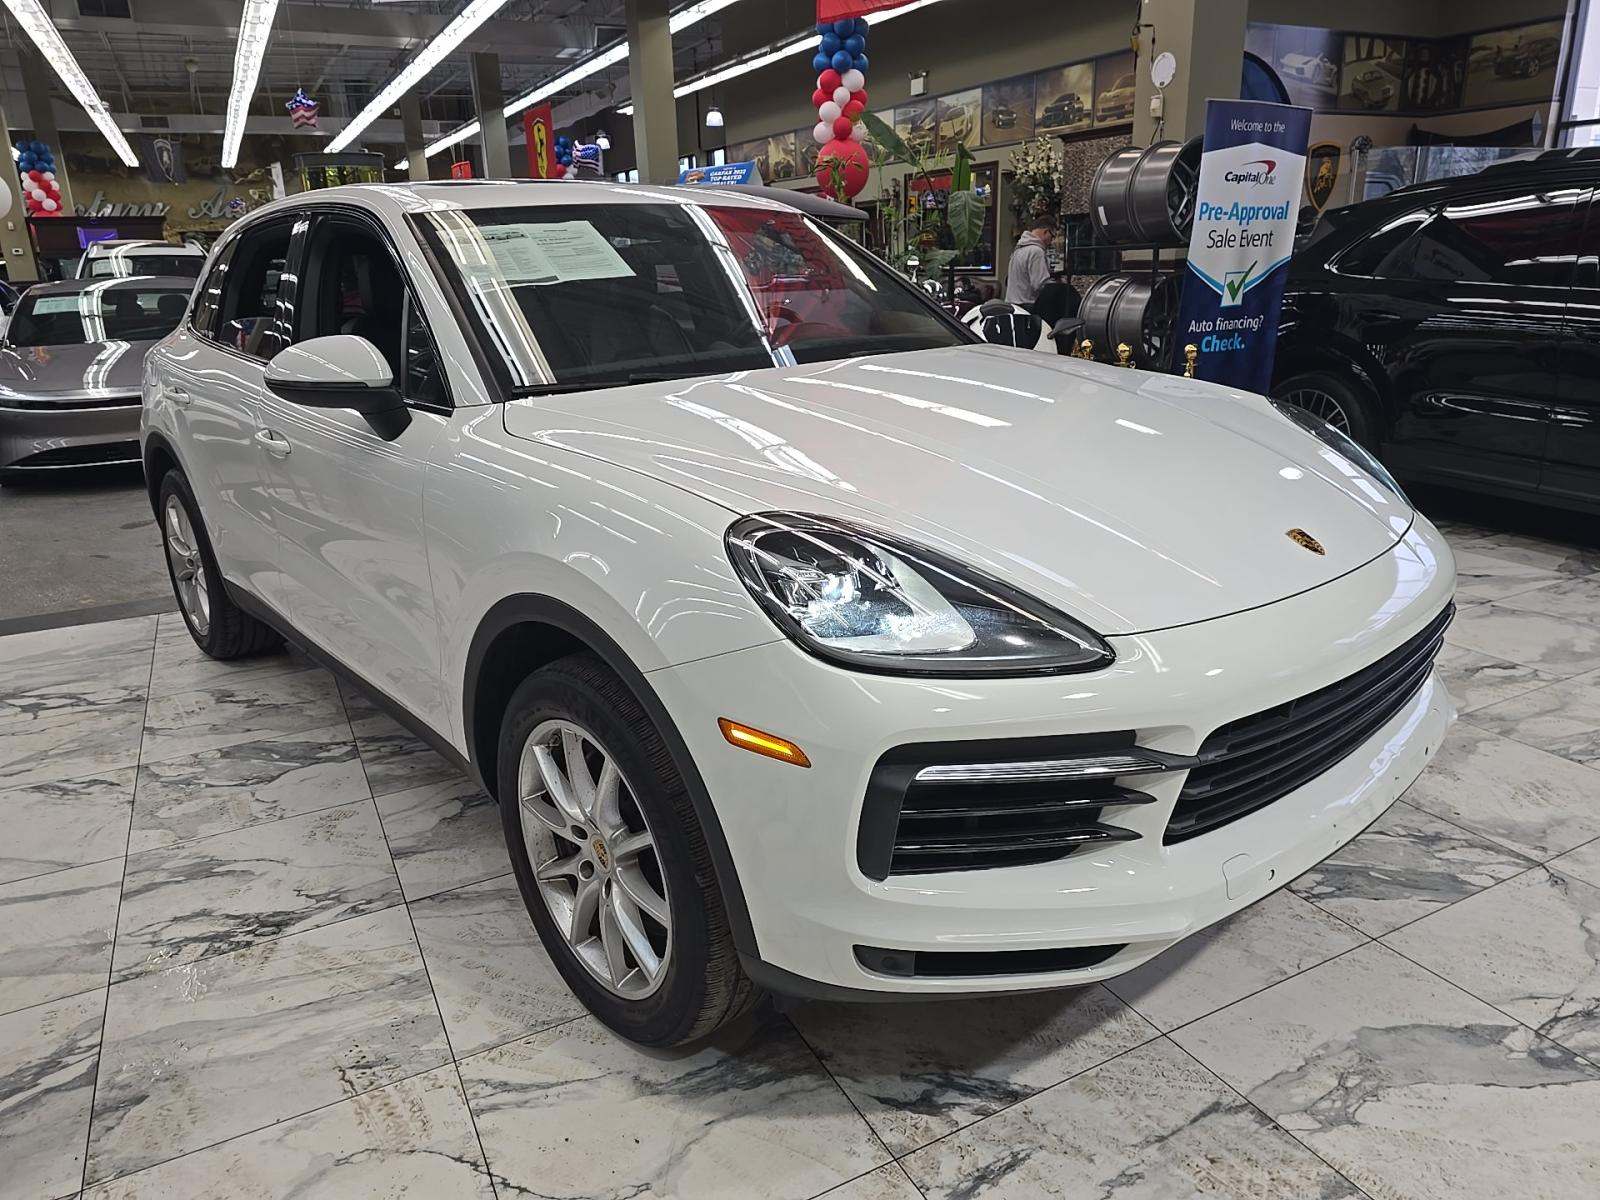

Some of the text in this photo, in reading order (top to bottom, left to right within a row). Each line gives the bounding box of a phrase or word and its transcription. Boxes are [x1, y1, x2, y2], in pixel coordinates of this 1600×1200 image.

[1230, 118, 1286, 133] Welcome to the
[1199, 201, 1289, 226] Pre-Approval
[1206, 228, 1274, 248] Sale Event
[1188, 314, 1264, 333] Auto financing?
[1201, 333, 1245, 353] Check.
